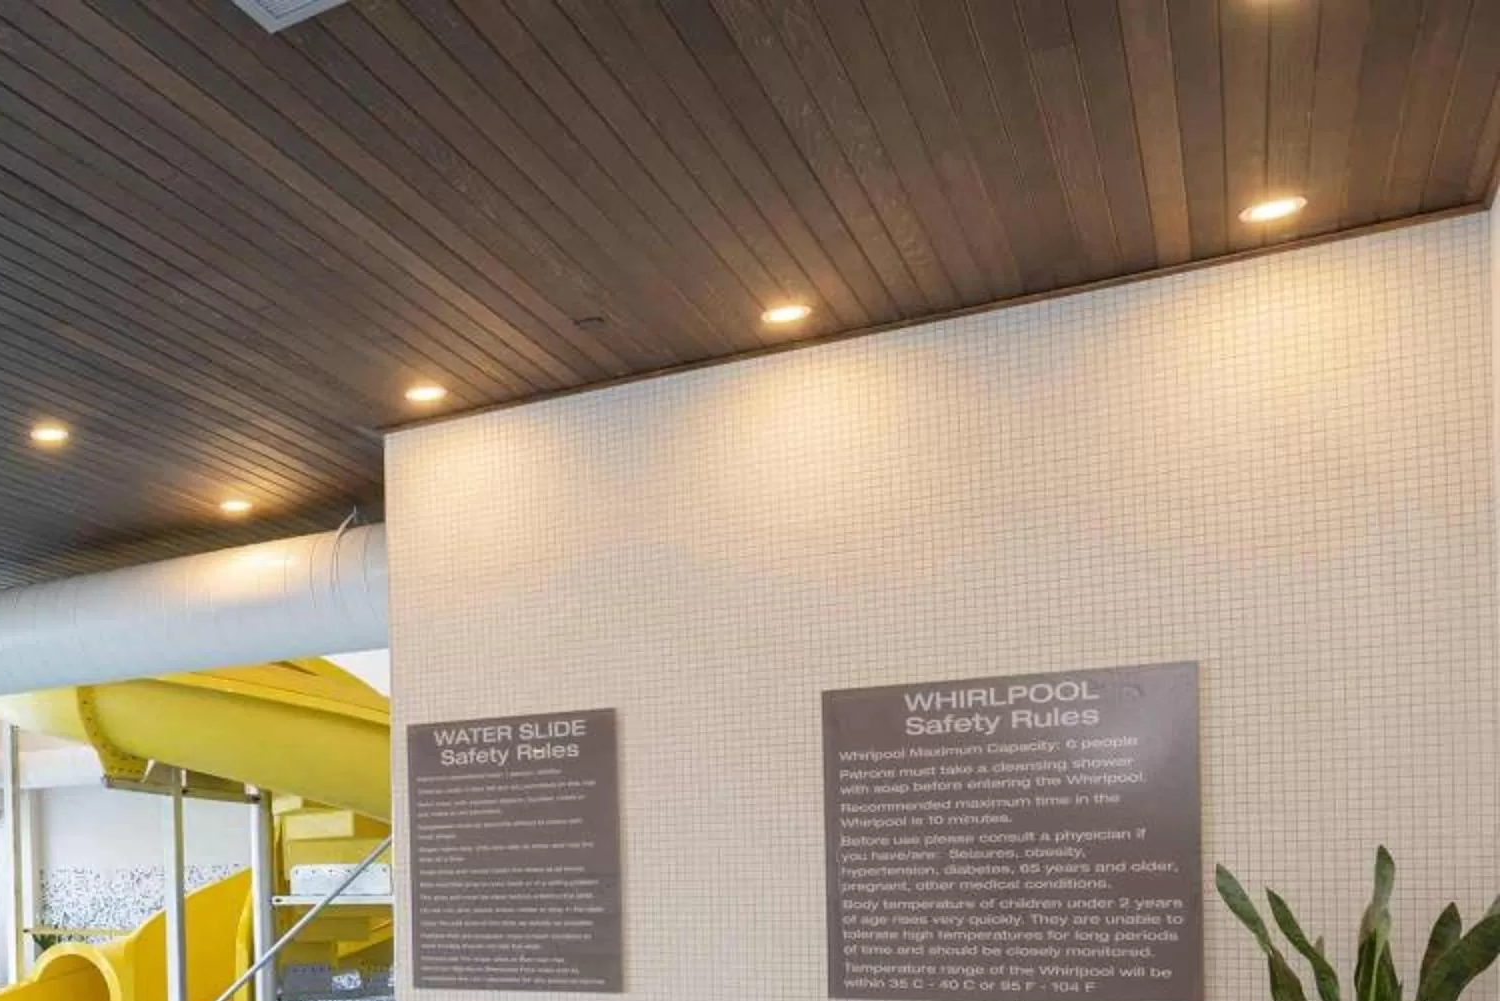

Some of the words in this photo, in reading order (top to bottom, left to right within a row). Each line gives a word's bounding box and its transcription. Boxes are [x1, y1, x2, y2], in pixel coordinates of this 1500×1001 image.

[903, 680, 1100, 712] WHIRLPOOL
[904, 711, 1000, 740] Safety
[1011, 704, 1100, 729] Rules
[434, 725, 512, 747] WATER
[519, 719, 587, 740] SLIDE
[441, 746, 509, 767] Safety
[517, 742, 580, 760] Rules
[838, 749, 904, 764] Whirlpool
[909, 744, 982, 758] Maximum
[899, 765, 935, 777] must
[940, 763, 974, 774] take
[978, 764, 987, 772] a
[995, 757, 1067, 774] cleansing
[1072, 754, 1132, 768] shower
[840, 785, 868, 795] with
[913, 780, 961, 792] before
[966, 777, 1031, 792] entering
[1035, 775, 1061, 786] the
[1066, 771, 1146, 787] Whirlpool.
[839, 799, 950, 813] Recommended
[955, 796, 1030, 808] maximum
[1034, 794, 1069, 805] time
[1075, 793, 1090, 804] in
[1093, 792, 1119, 803] the
[840, 816, 906, 830] Whirlpool
[911, 816, 922, 825] is
[928, 815, 944, 825] 10
[947, 812, 1012, 824] minutes.
[840, 836, 889, 846] Before
[893, 837, 919, 845] use
[924, 833, 974, 846] please
[979, 831, 1034, 842] consult
[1055, 828, 1130, 842] physician
[1135, 828, 1146, 838] if
[841, 853, 867, 863] you
[1045, 864, 1090, 875] years
[1095, 862, 1125, 871] and
[915, 880, 954, 890] other
[960, 879, 1020, 889] medical
[1025, 878, 1111, 888] conditions.
[842, 901, 878, 912] Body
[883, 900, 976, 911] temperature
[979, 899, 995, 908] of
[999, 899, 1062, 908] children
[1066, 898, 1114, 908] under
[1118, 898, 1130, 907] 2
[1135, 900, 1182, 909] years
[842, 916, 857, 924] of
[860, 918, 887, 926] age
[932, 917, 964, 926] very
[969, 915, 1023, 926] quickly.
[1031, 915, 1067, 926] They
[1105, 914, 1160, 923] unable
[1165, 914, 1183, 923] to
[903, 931, 933, 942] high
[937, 931, 1042, 942] temperatures
[1046, 931, 1069, 940] for
[1074, 931, 1108, 942] long
[1113, 931, 1178, 942] periods
[843, 946, 857, 954] of
[861, 946, 893, 954] time
[897, 946, 923, 955] and
[928, 946, 977, 955] should
[981, 946, 1001, 955] be
[1006, 946, 1060, 958] closely
[843, 964, 936, 976] Temperature
[940, 967, 984, 977] range
[989, 965, 1005, 975] of
[1009, 966, 1034, 975] the
[1039, 966, 1113, 978] Whirlpool
[1119, 967, 1144, 976] will
[1149, 967, 1172, 977] be
[843, 979, 884, 988] within
